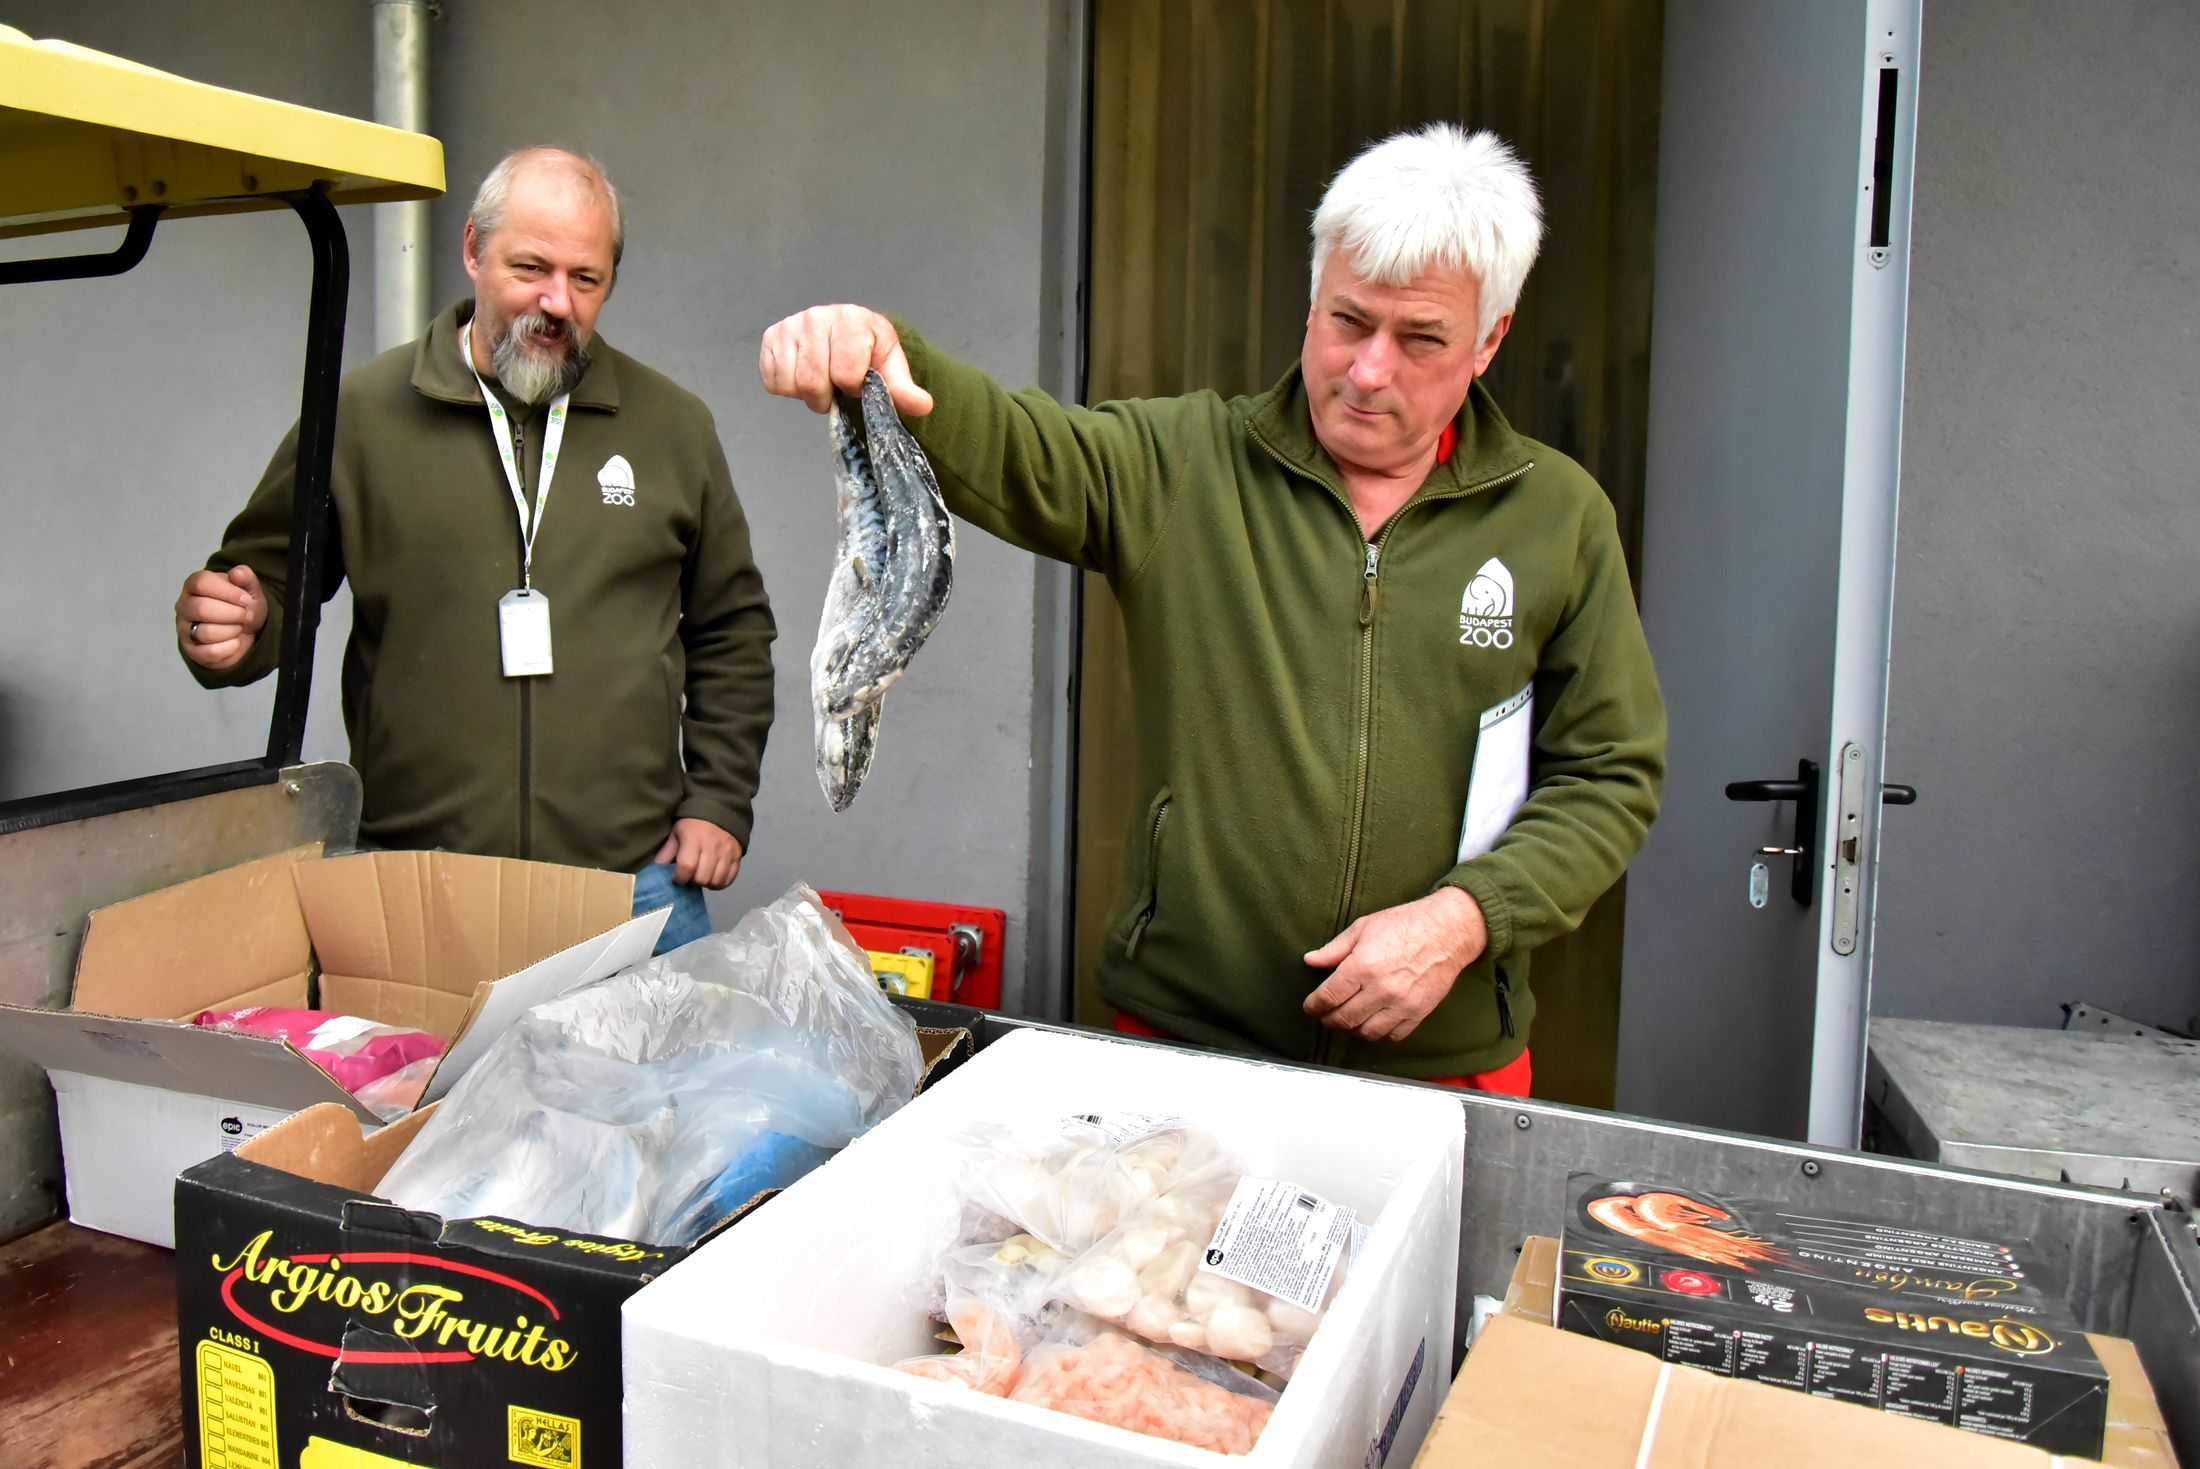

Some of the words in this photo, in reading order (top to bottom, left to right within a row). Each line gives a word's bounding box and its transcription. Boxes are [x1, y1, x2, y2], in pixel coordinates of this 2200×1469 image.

[602, 492, 635, 506] ZOO
[1460, 614, 1512, 628] BUDAPEST
[1460, 625, 1513, 649] ZOO
[222, 1122, 241, 1132] epic
[472, 1219, 559, 1245] Fruits
[562, 1239, 664, 1261] Argios
[1798, 1251, 1914, 1273] ARGENTINO
[1911, 1258, 1935, 1266] RED
[212, 1230, 398, 1313] Argios
[393, 1284, 578, 1371] Fruits
[1607, 1310, 1661, 1334] Nautis
[1864, 1307, 2042, 1350] Nautis
[209, 1326, 251, 1350] CLASS
[224, 1361, 242, 1373] NAVEL
[224, 1378, 256, 1394] NAVELINAS
[225, 1395, 253, 1411] VALENCIA
[536, 1416, 570, 1432] HELLAS
